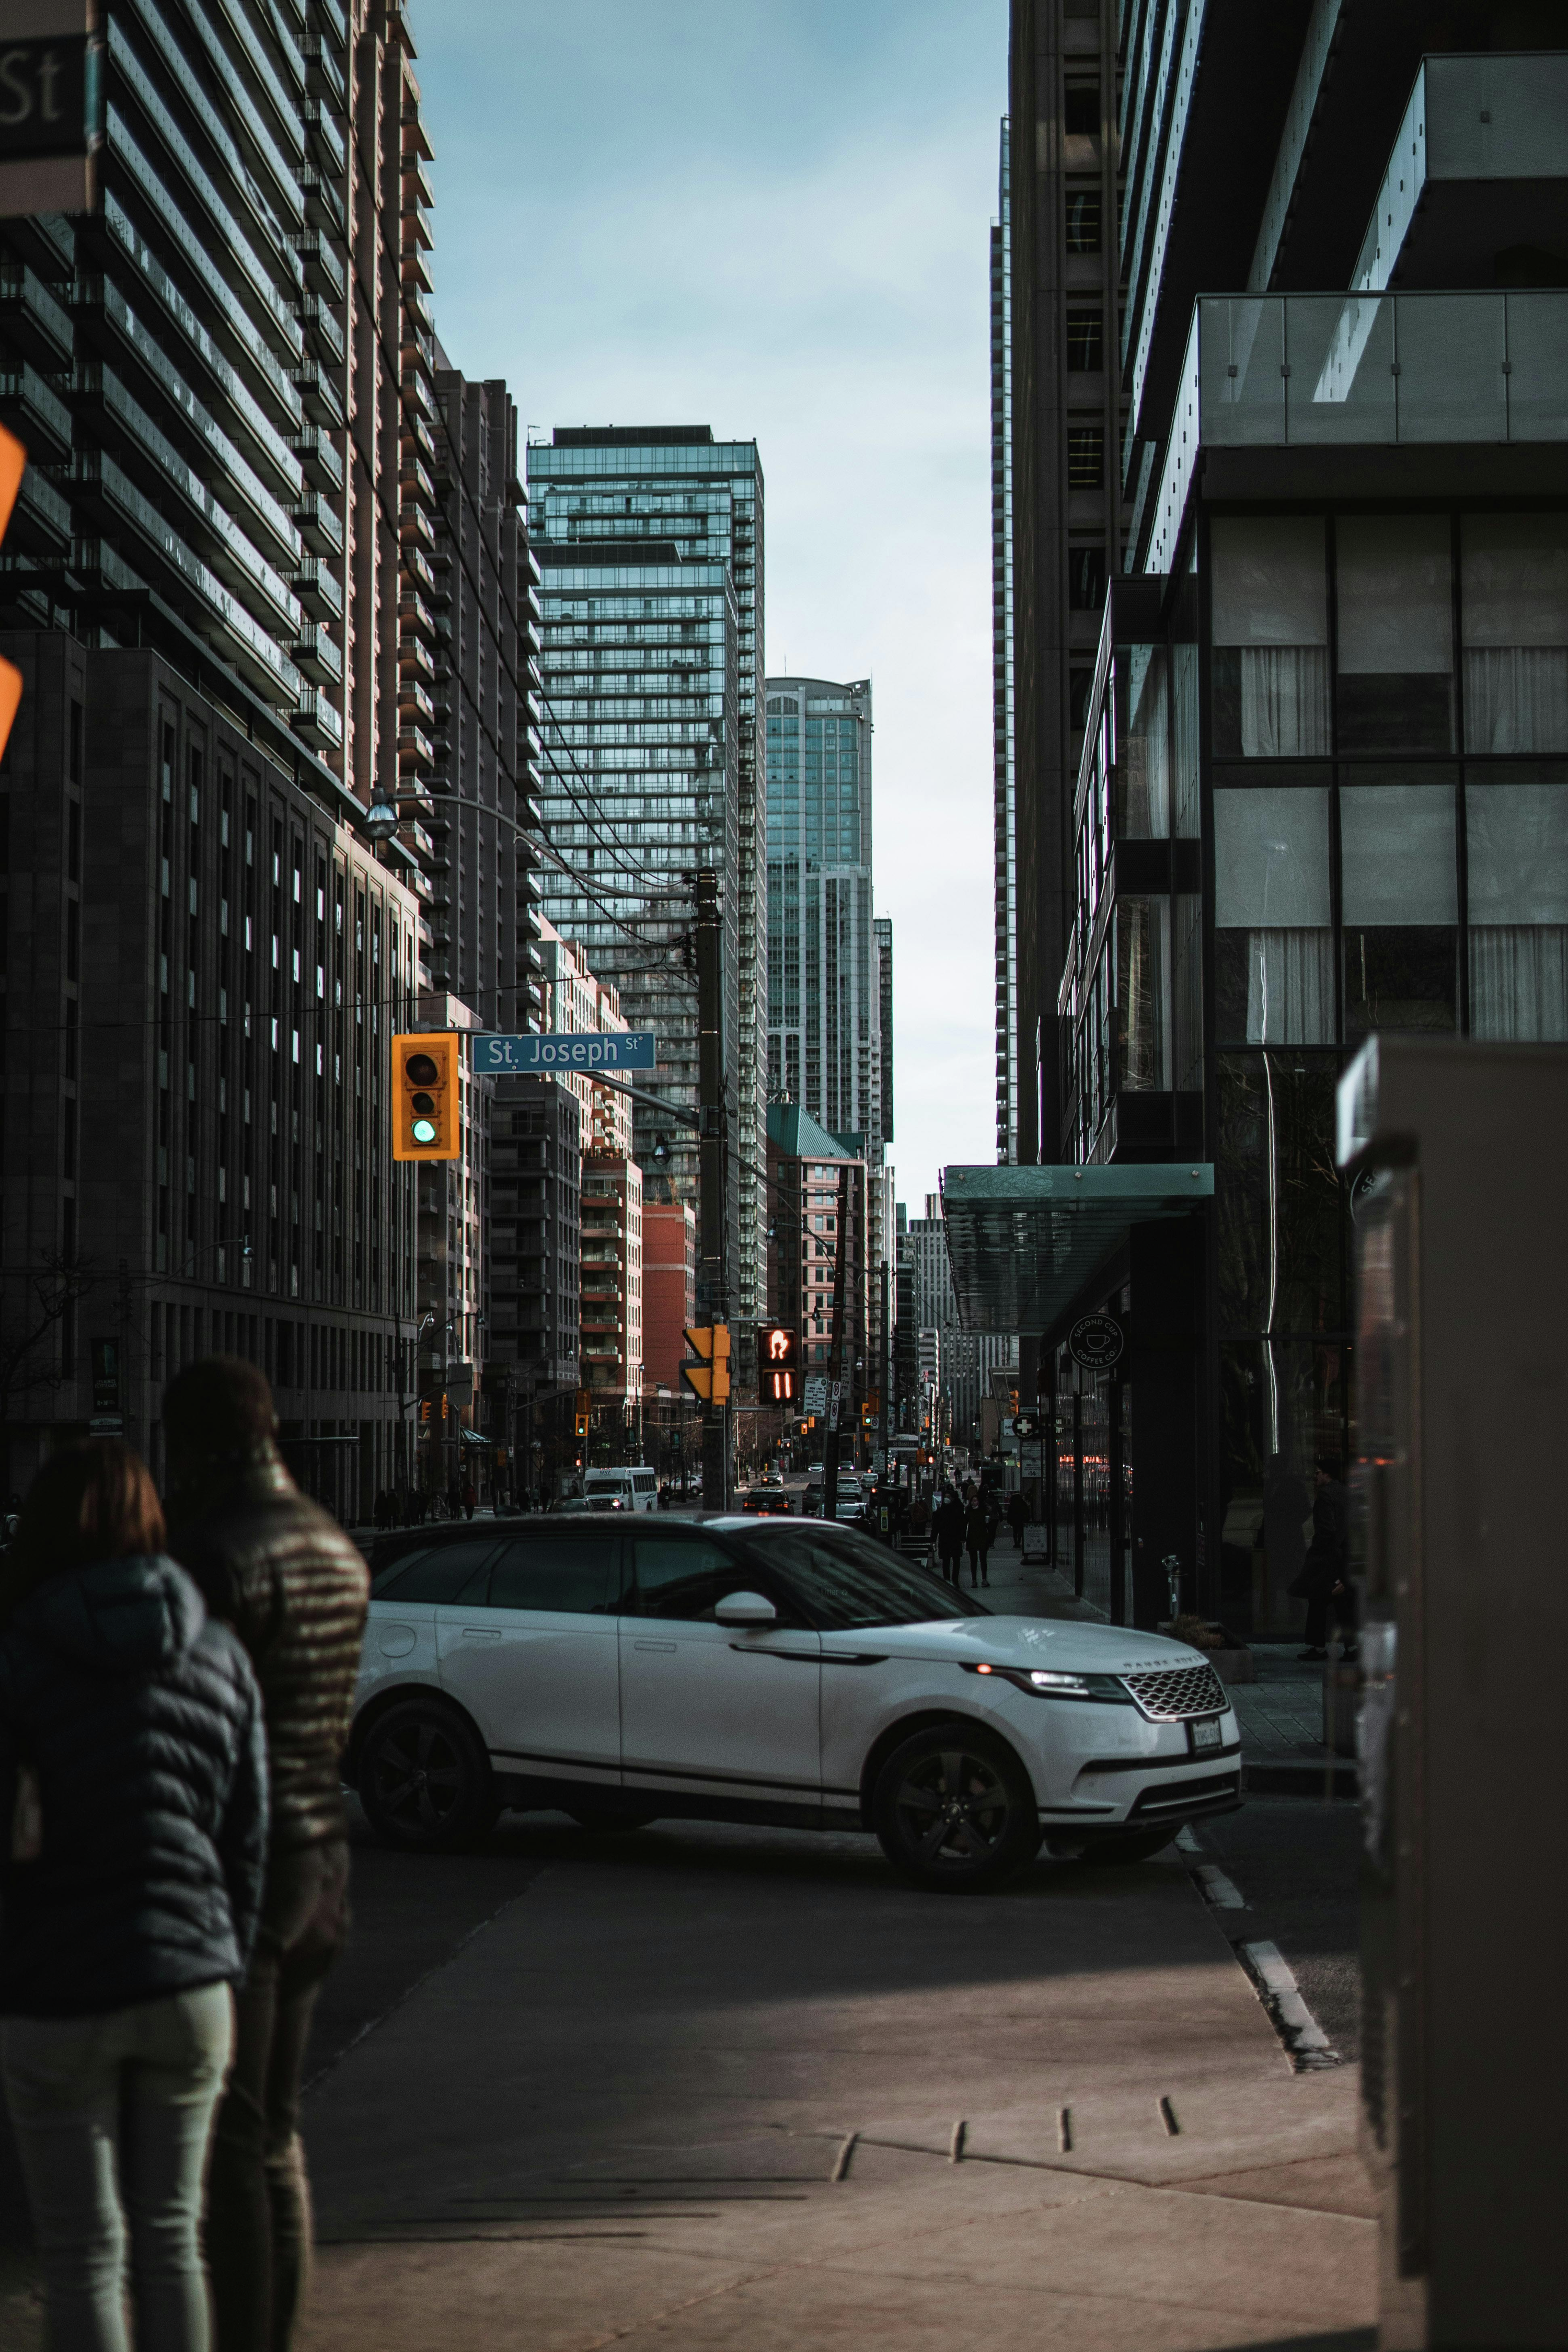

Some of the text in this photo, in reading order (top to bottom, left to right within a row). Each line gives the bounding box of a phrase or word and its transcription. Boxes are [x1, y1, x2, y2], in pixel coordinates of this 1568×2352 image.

[0, 50, 61, 123] St
[489, 1037, 639, 1067] St. Joseph St
[1074, 1319, 1118, 1338] SECOND CUP
[1077, 1349, 1104, 1364] COFFEE
